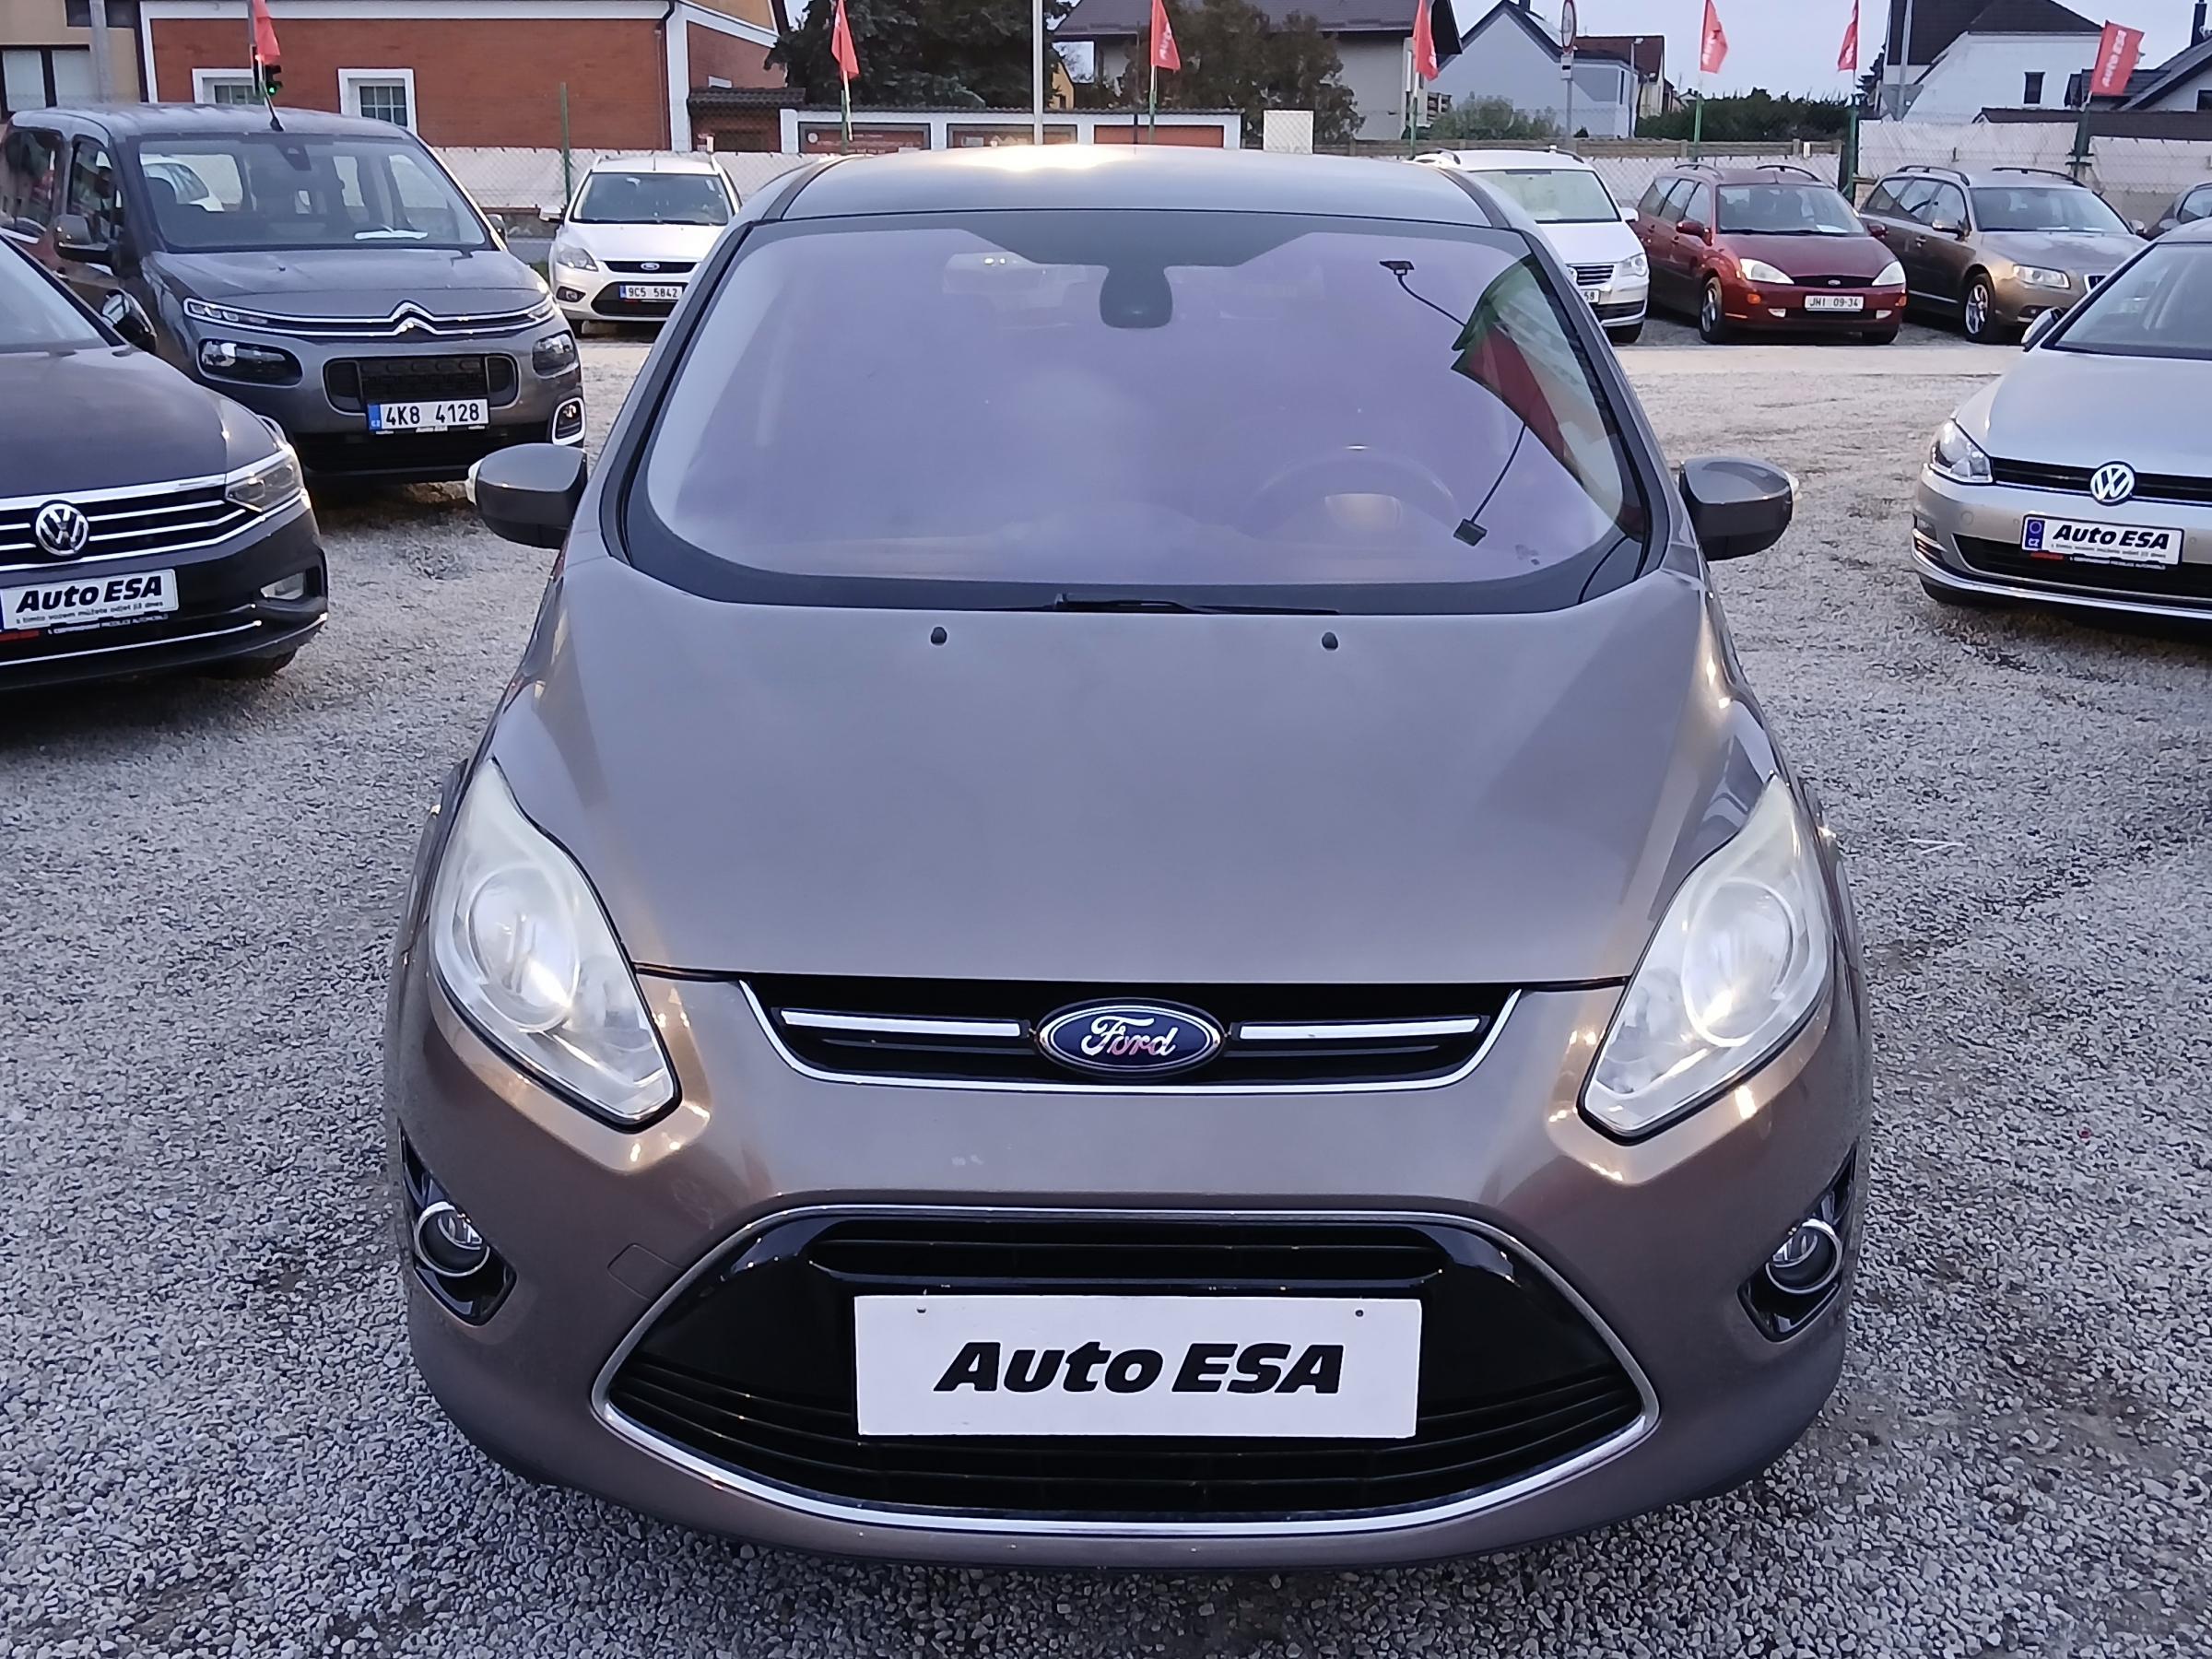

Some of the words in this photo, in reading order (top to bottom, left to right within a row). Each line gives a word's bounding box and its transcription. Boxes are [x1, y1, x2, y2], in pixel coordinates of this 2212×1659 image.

[629, 288, 646, 297] 9C5
[1833, 298, 1858, 307] 09-34
[386, 406, 420, 426] 4K8
[435, 403, 480, 423] 4128
[2053, 524, 2117, 545] Auto
[2119, 530, 2170, 549] ESA
[16, 585, 100, 613] Auto
[103, 576, 162, 603] ESA
[1080, 1016, 1179, 1055] Ford
[933, 1341, 1163, 1394] Auto
[1171, 1342, 1344, 1394] ESA
